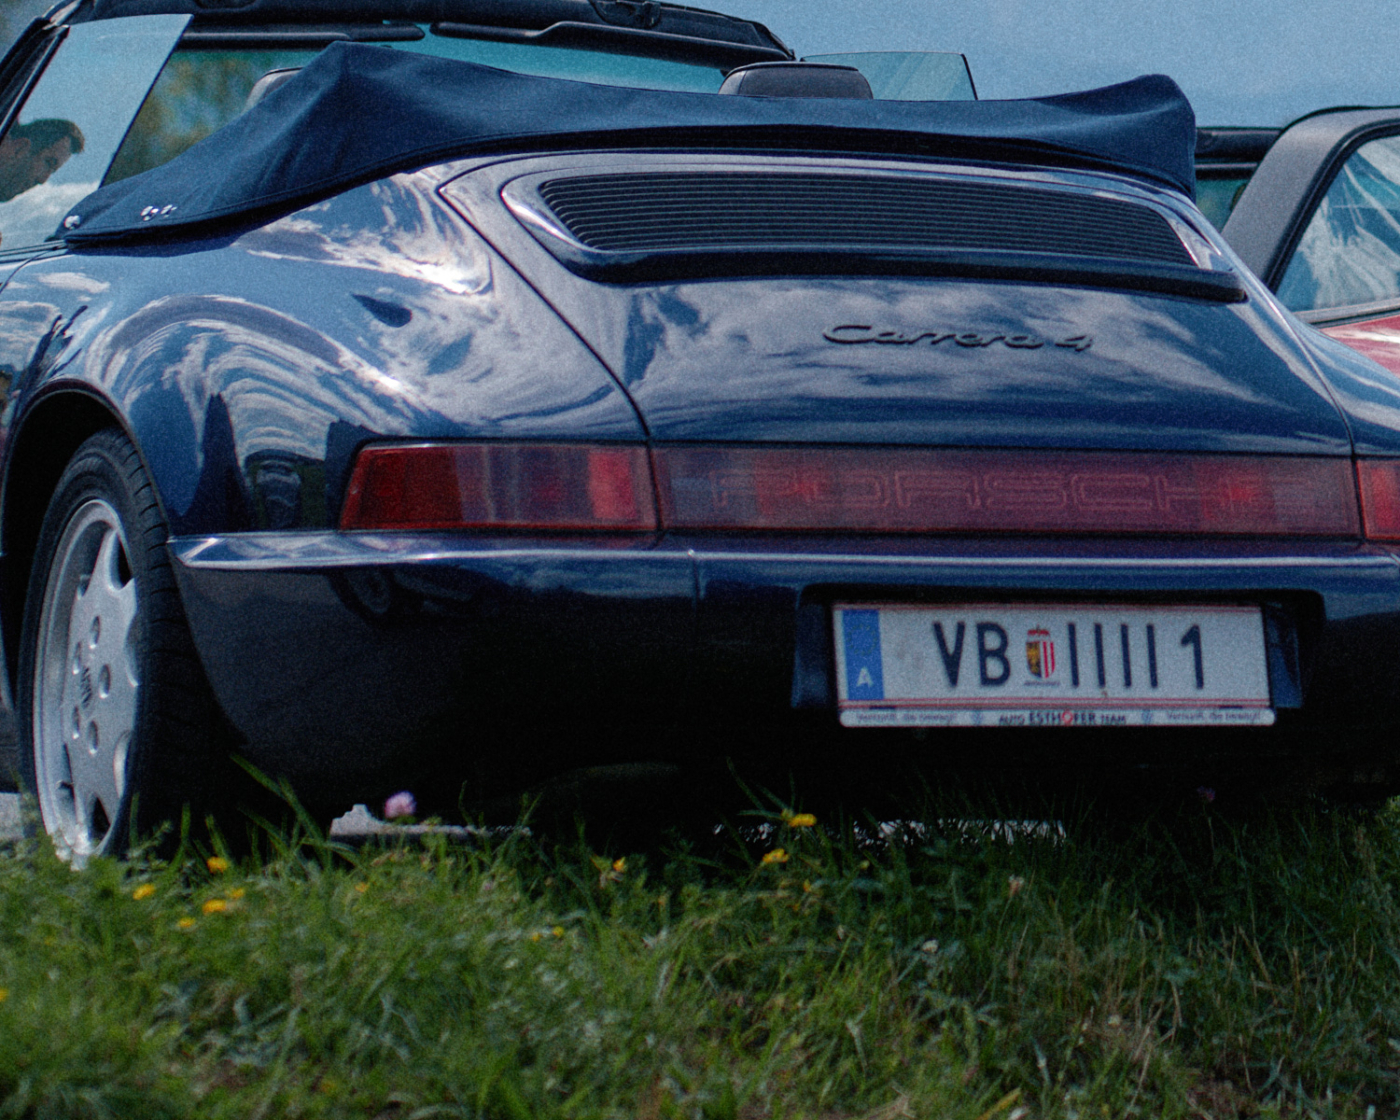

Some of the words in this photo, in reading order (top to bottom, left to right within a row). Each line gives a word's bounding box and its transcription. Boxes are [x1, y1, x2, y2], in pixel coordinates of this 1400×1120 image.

[822, 324, 1044, 349] Carrera
[1054, 335, 1092, 352] 4
[932, 621, 1012, 687] VB
[856, 666, 874, 687] A
